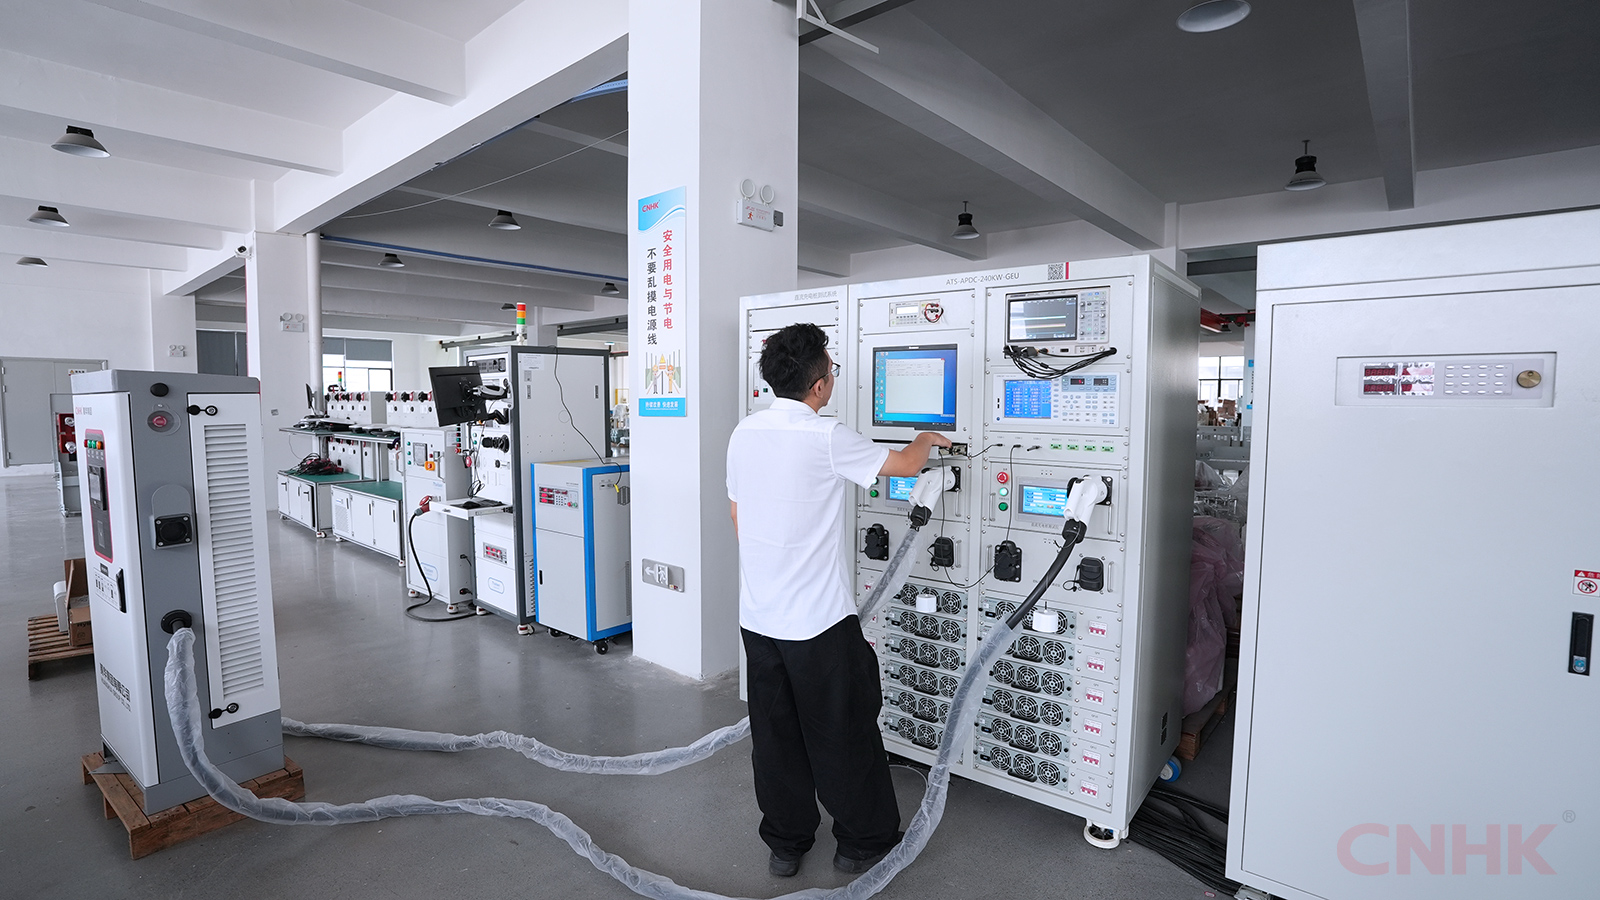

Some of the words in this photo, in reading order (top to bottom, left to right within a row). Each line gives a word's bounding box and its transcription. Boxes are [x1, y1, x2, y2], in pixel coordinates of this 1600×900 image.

[642, 202, 659, 213] CNHK
[646, 247, 657, 345] 不要乱摸电源线
[662, 229, 673, 330] 安全用电与节电
[945, 272, 1020, 286] ATS-APDC-240KW-GEU
